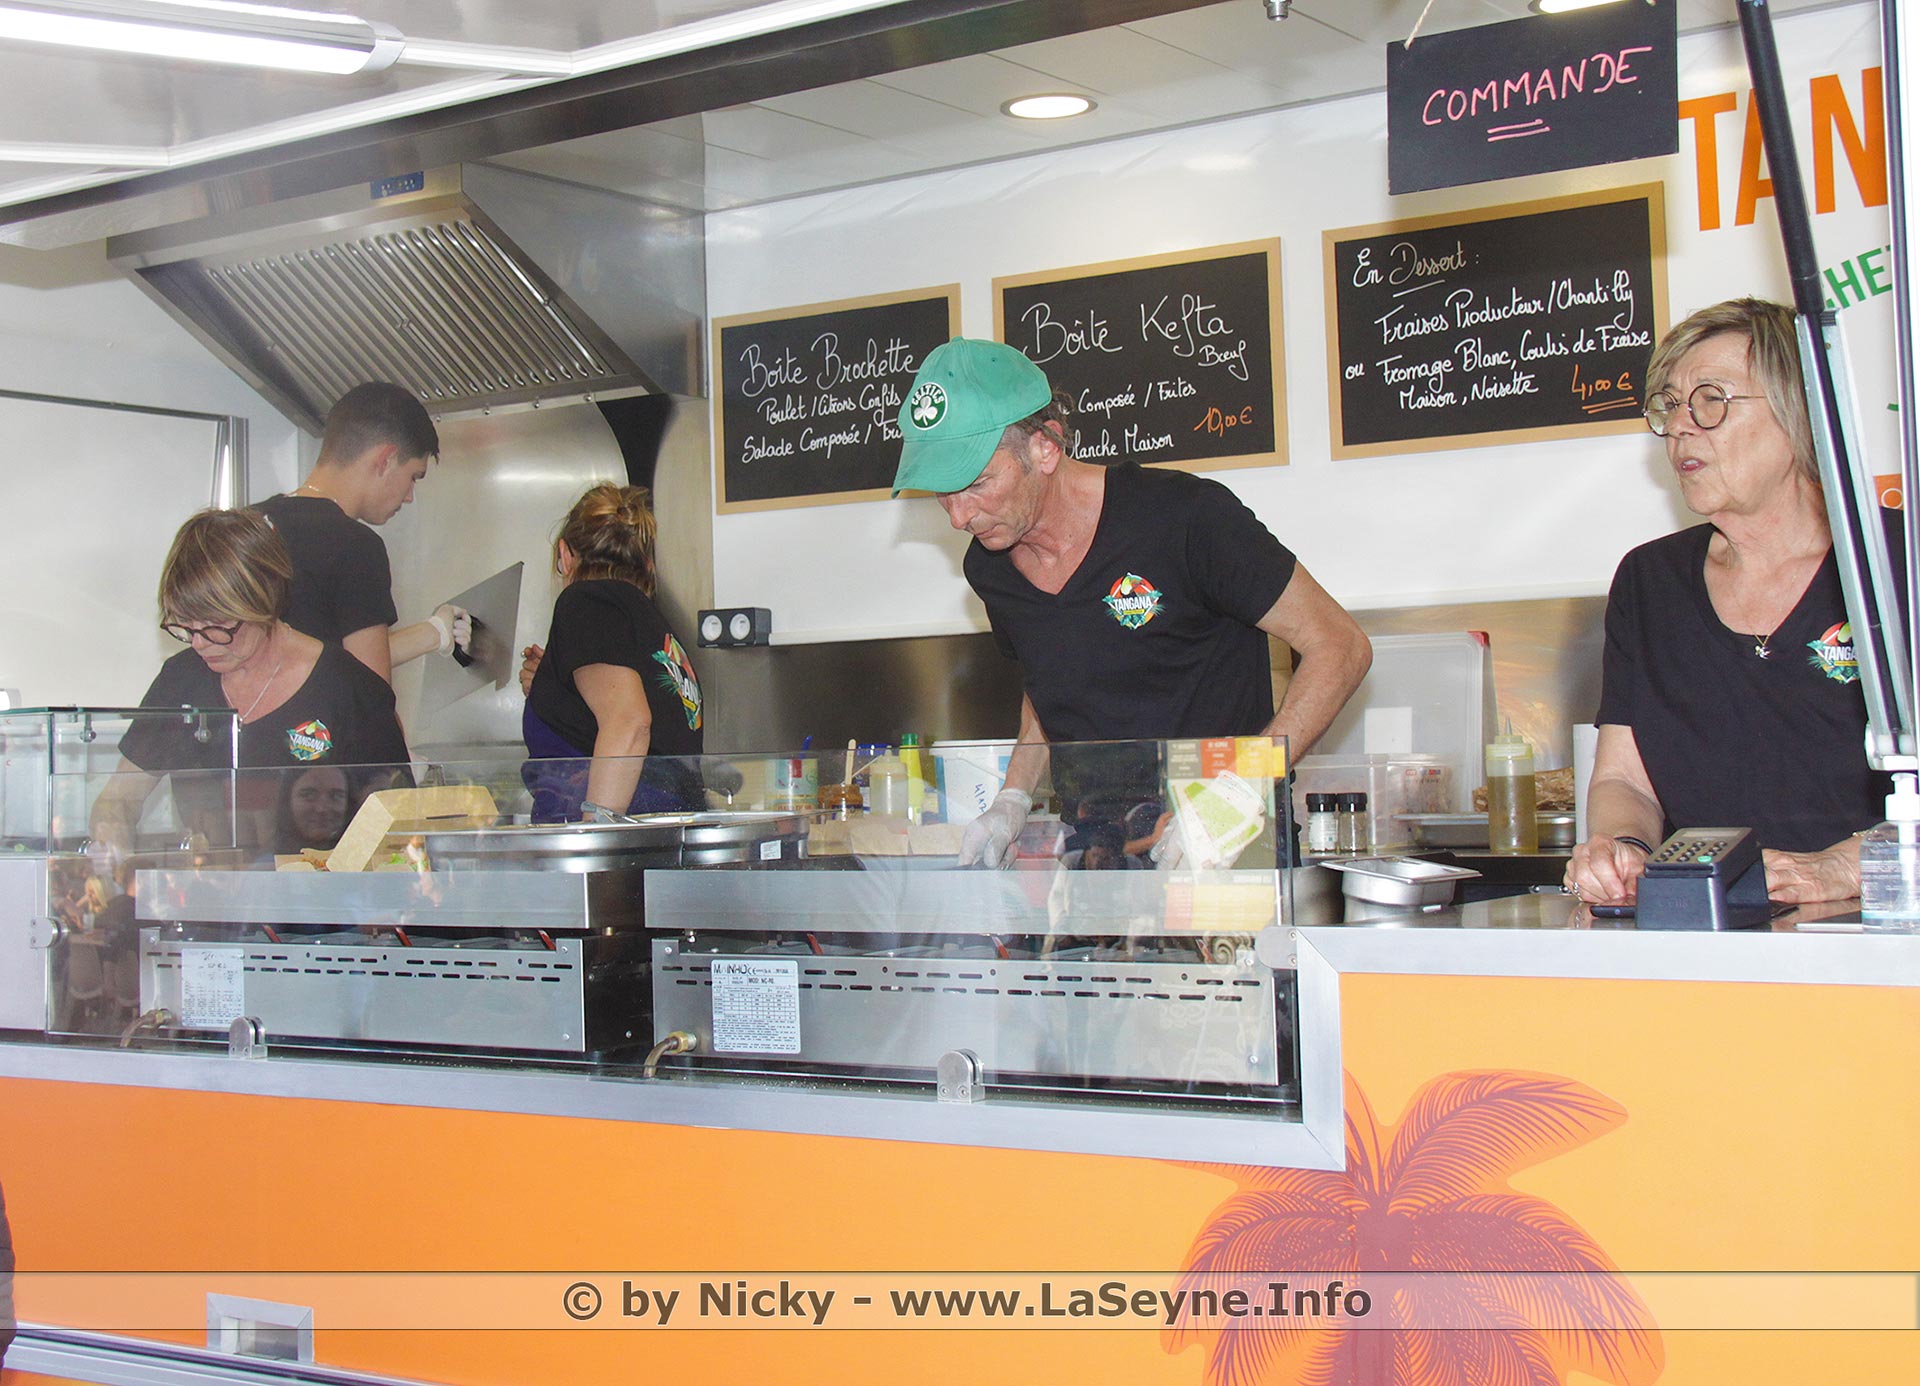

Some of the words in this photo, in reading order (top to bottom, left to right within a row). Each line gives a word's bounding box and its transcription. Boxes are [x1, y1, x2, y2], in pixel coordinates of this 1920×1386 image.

[1423, 46, 1653, 125] COMMANDE
[1353, 247, 1384, 288] En
[1389, 240, 1466, 285] Dessert
[1825, 244, 1893, 309] HE
[1140, 293, 1234, 357] Kefta
[1374, 304, 1449, 345] Fraises
[1445, 287, 1544, 329] Producteur
[810, 332, 920, 391] Brochette
[1345, 362, 1365, 381] ou
[1375, 354, 1454, 394] Fromage
[1520, 328, 1569, 361] Coulis
[1572, 328, 1597, 353] de
[1595, 325, 1651, 352] Fraise
[911, 384, 945, 406] CELTICS
[1077, 384, 1136, 420] Composée
[1157, 377, 1197, 401] Frites
[1471, 370, 1539, 402] Noisette
[757, 393, 808, 425] Poulet
[742, 435, 795, 464] Salade
[799, 424, 861, 459] Composée
[1064, 429, 1119, 460] lanche
[1124, 423, 1174, 454] Maison
[1113, 595, 1155, 611] TANGANA
